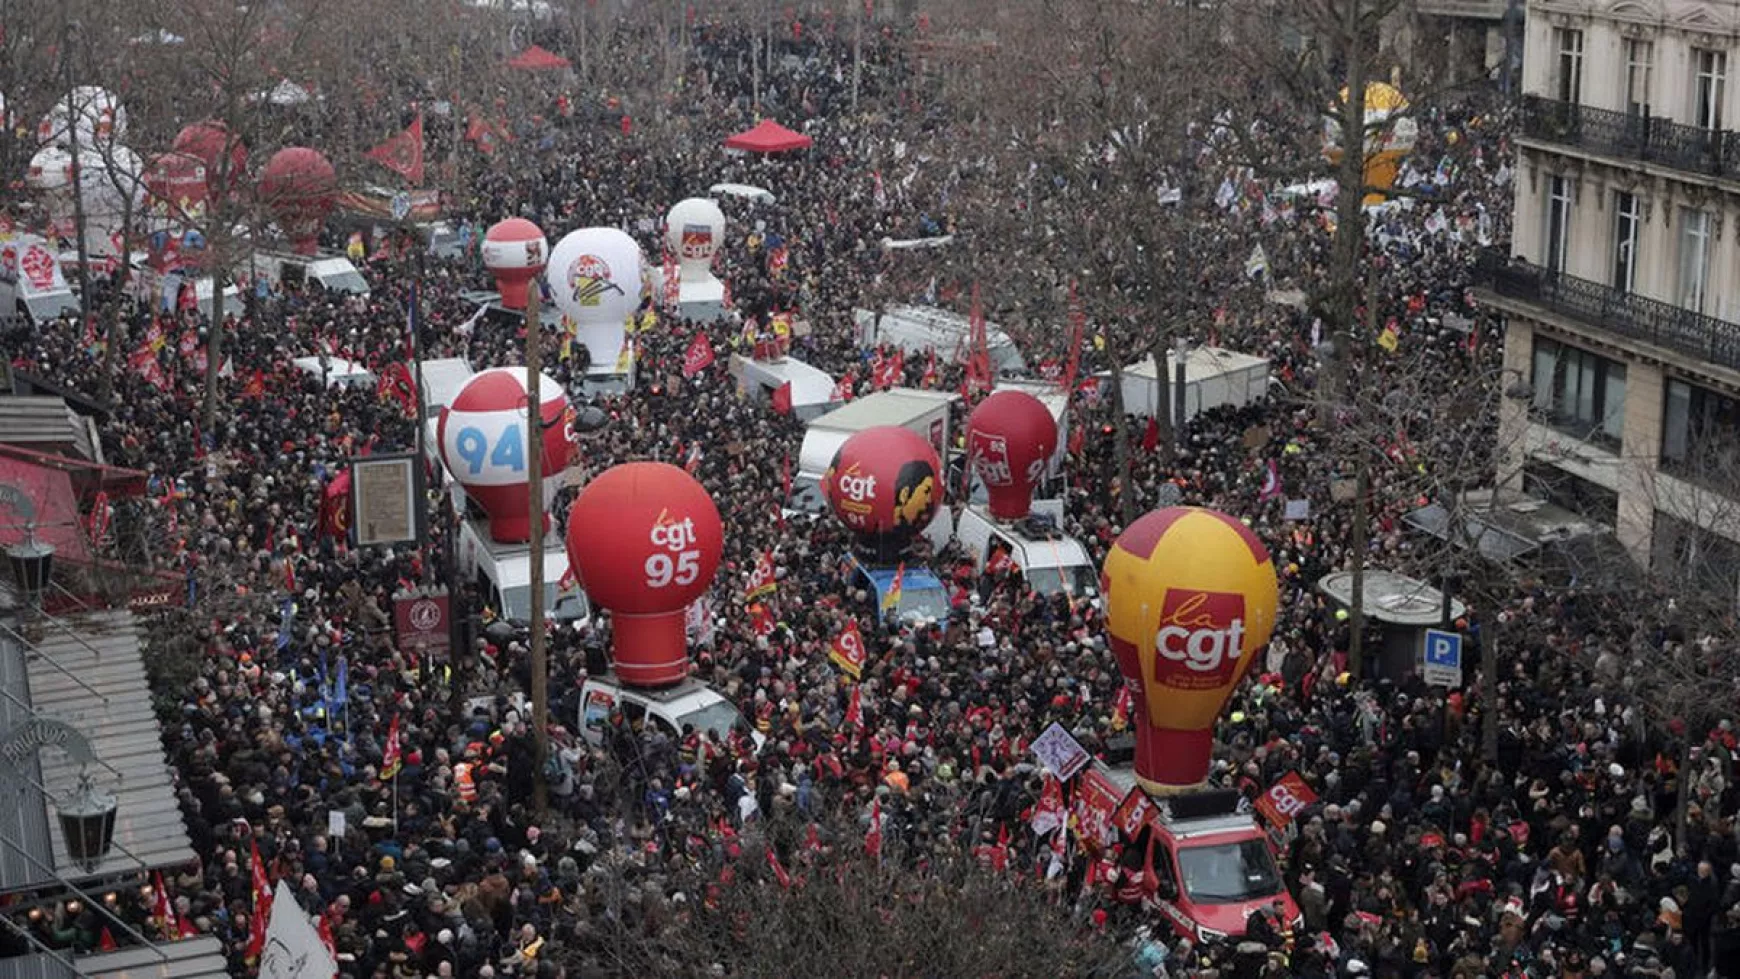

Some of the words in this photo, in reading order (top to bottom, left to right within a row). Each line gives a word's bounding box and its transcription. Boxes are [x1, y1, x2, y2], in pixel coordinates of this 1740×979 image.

[455, 423, 523, 474] 94
[840, 475, 876, 501] cgt
[650, 516, 697, 552] cgt
[644, 549, 700, 588] 95
[1162, 592, 1218, 629] la
[1156, 617, 1246, 672] cgt
[1433, 639, 1450, 660] P
[1270, 785, 1306, 817] cgt
